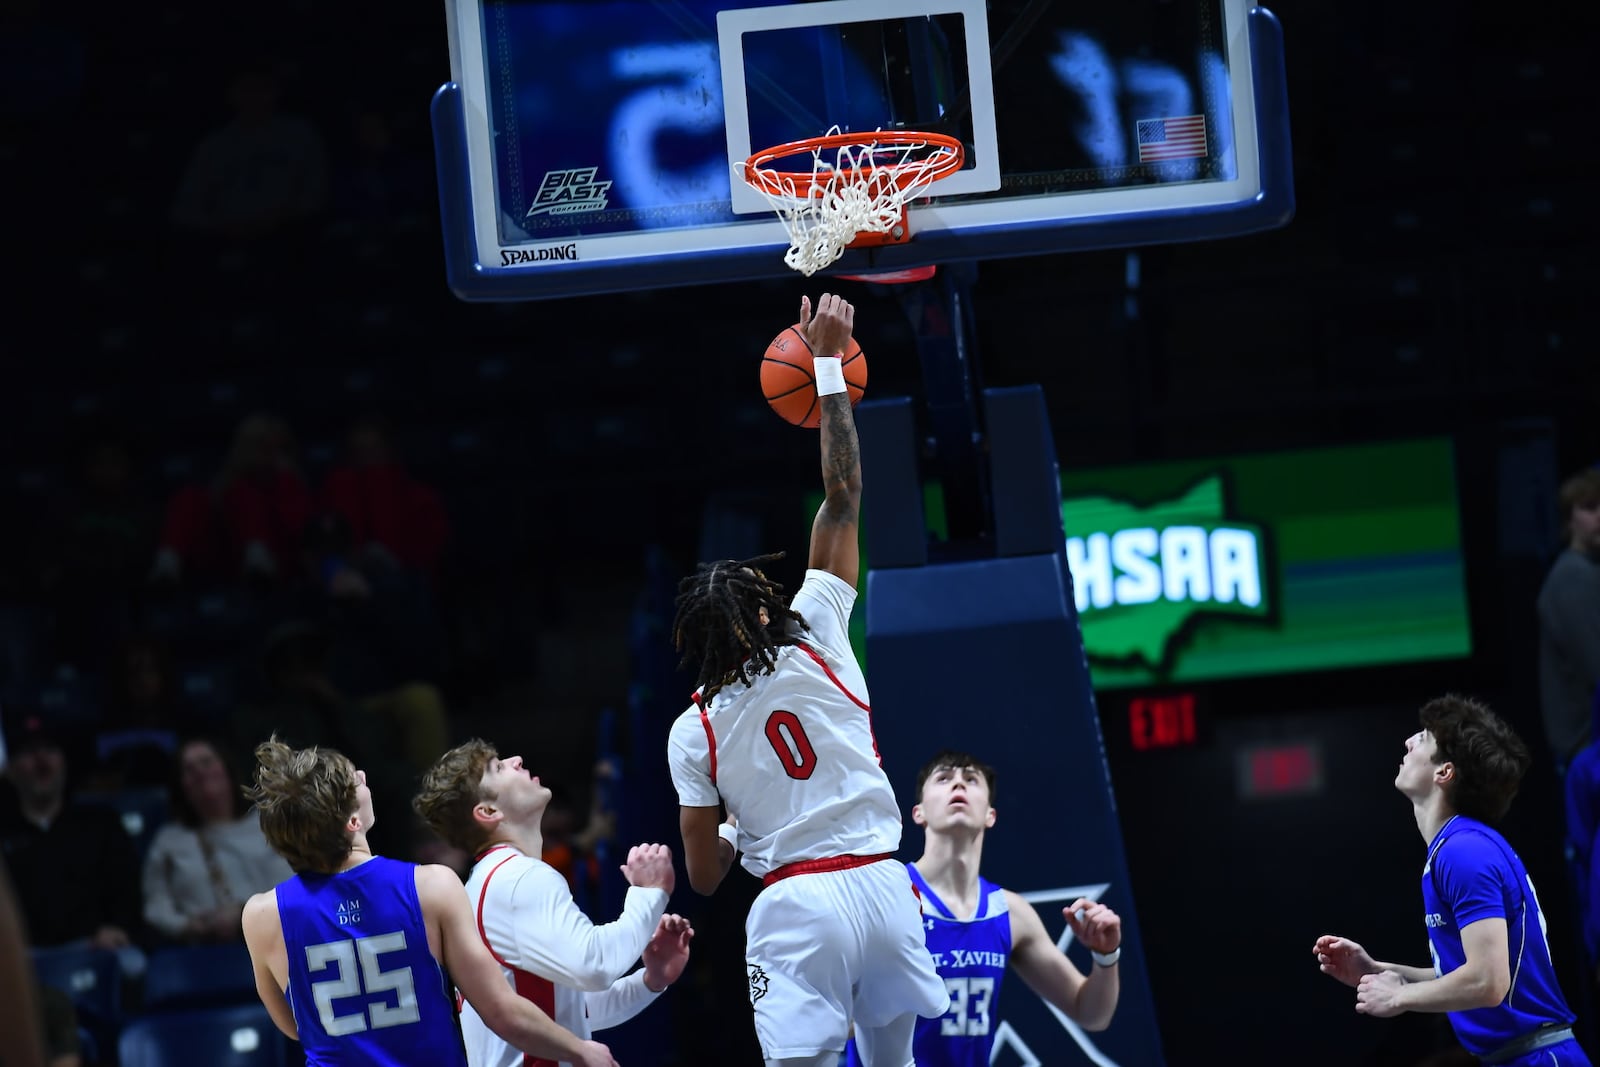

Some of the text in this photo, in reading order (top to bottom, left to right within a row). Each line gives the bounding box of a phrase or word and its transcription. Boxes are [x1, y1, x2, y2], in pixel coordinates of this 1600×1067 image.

[536, 183, 608, 203] EAST
[543, 169, 594, 189] BIG
[500, 243, 577, 267] SPALDING
[1066, 525, 1261, 613] HSAA
[764, 710, 817, 780] 0
[931, 953, 948, 967] T.
[304, 930, 421, 1037] 25
[940, 977, 994, 1036] 33
